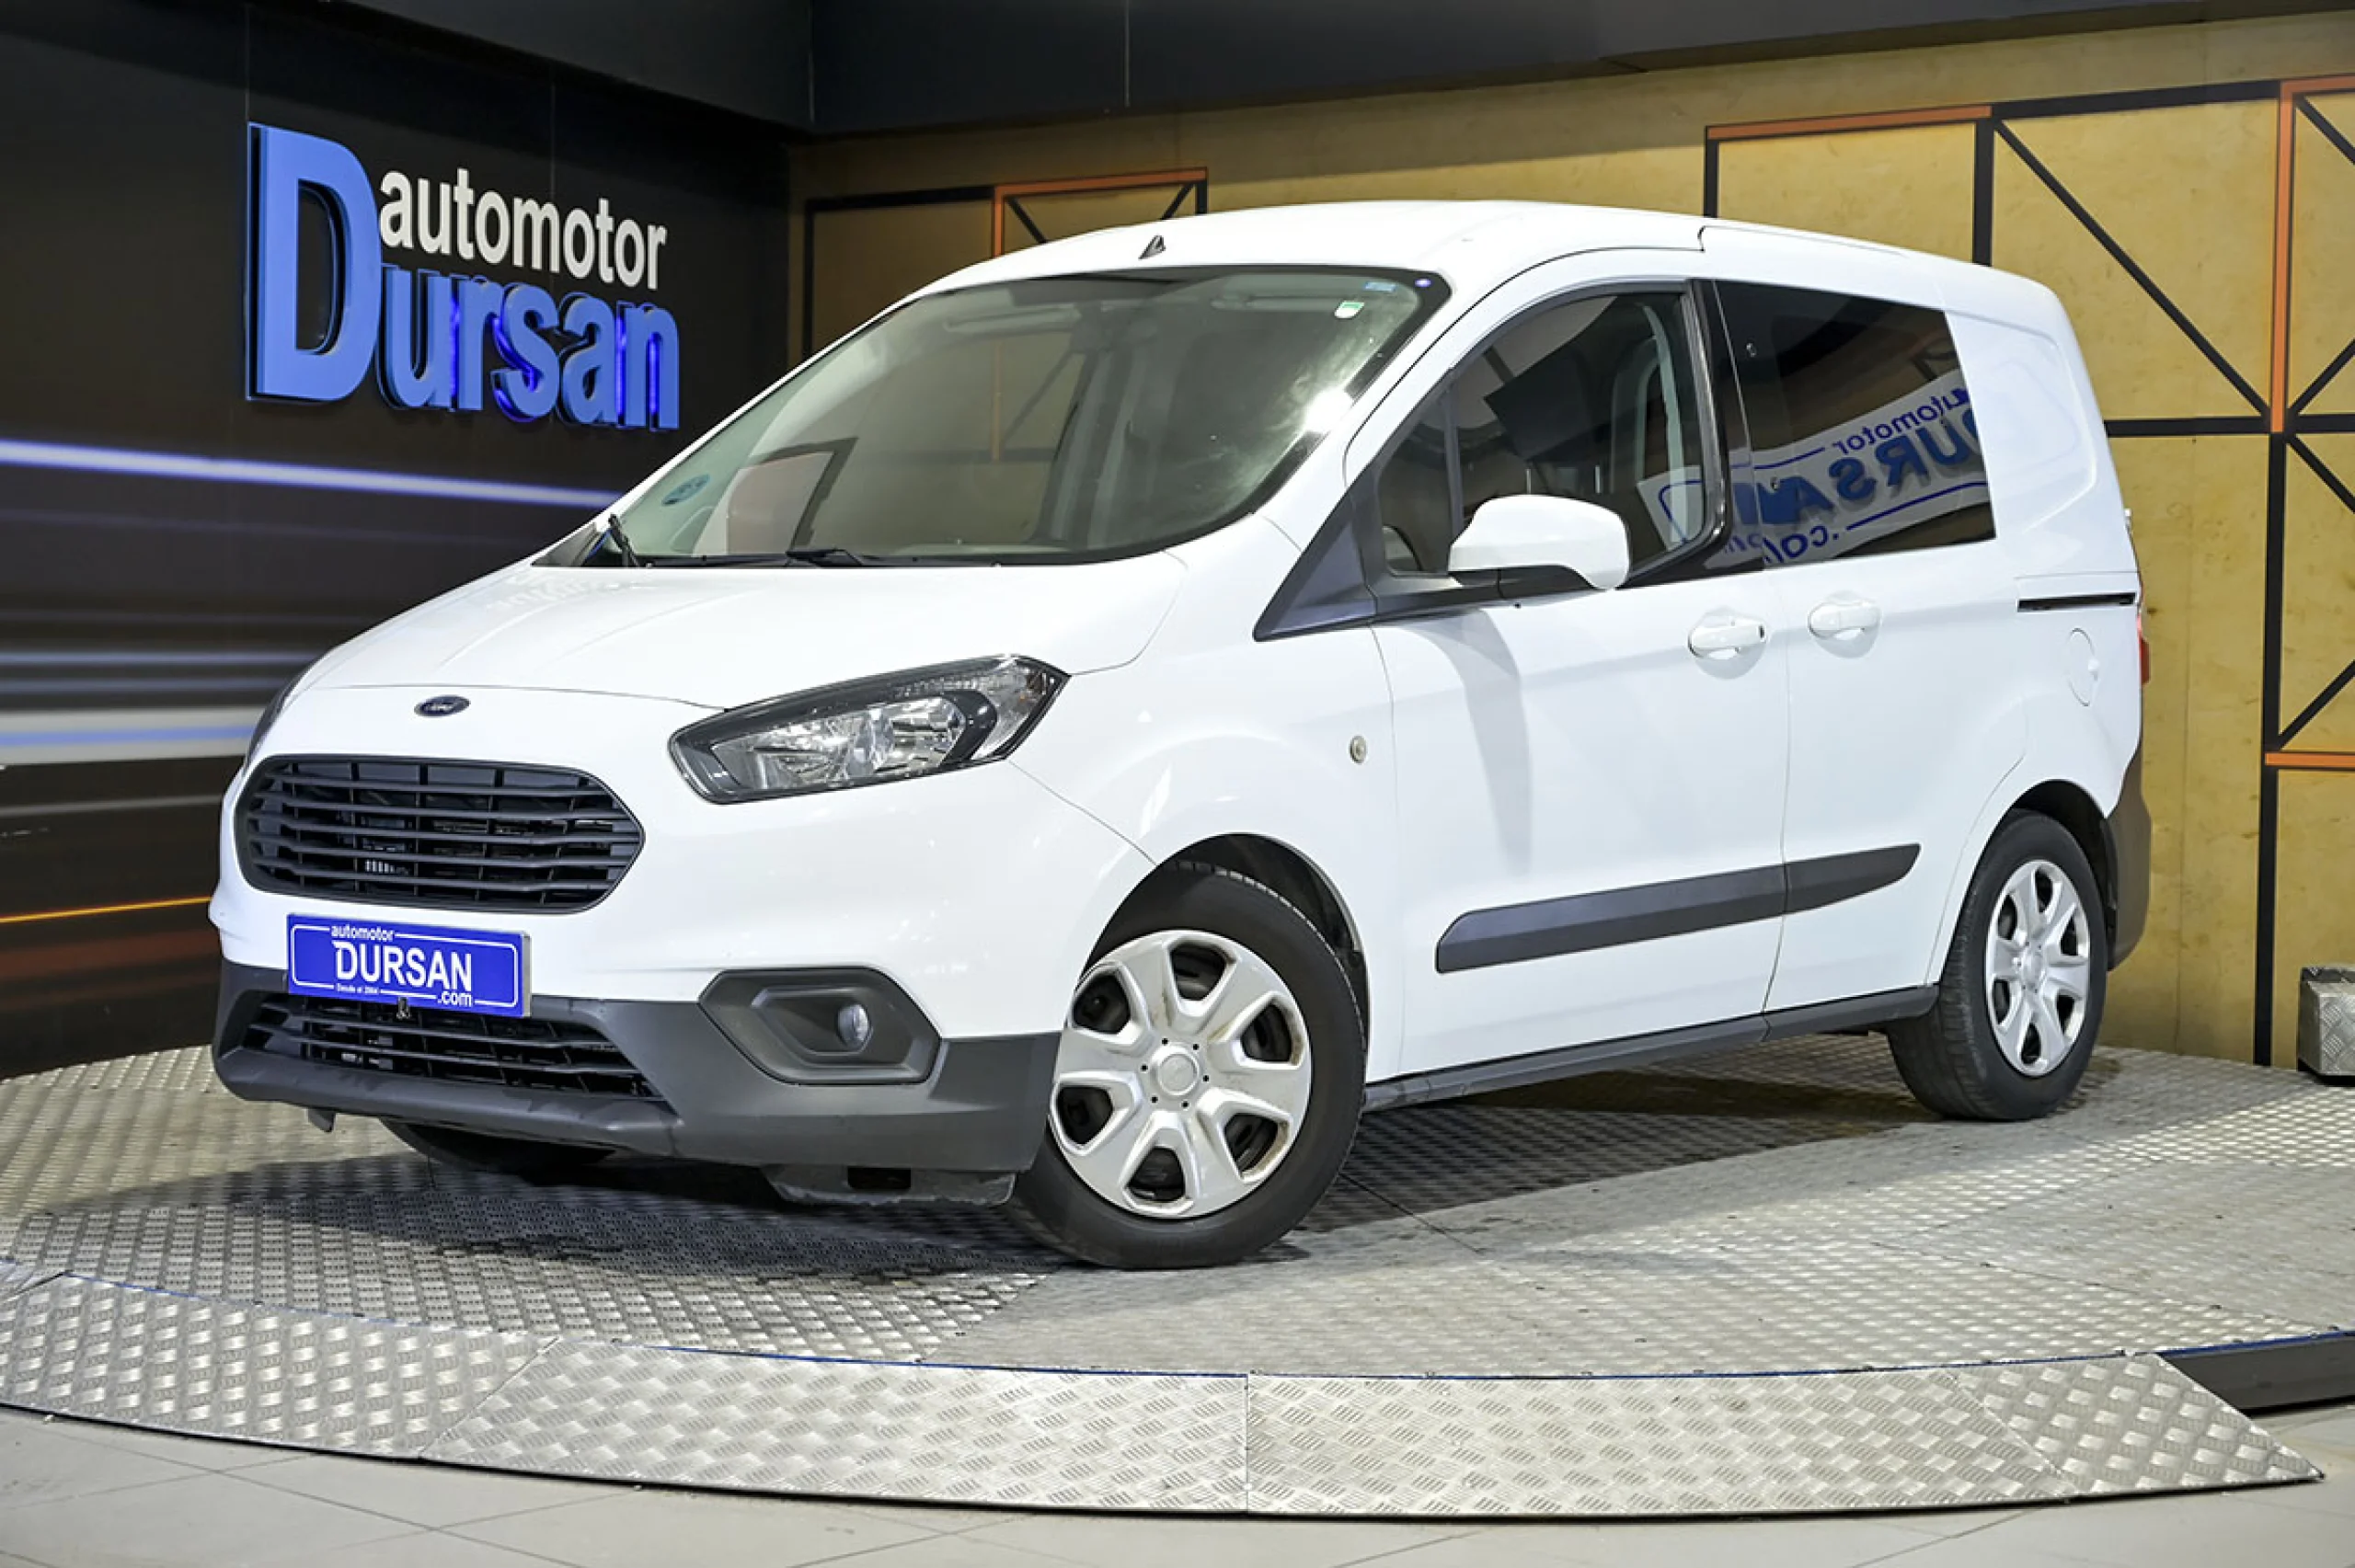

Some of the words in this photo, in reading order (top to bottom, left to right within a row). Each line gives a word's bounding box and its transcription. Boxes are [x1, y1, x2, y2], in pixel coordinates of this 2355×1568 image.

[380, 167, 668, 290] automotor
[247, 120, 680, 430] Dursan
[330, 923, 396, 943] automotor
[331, 939, 473, 992] DURSAN
[437, 990, 473, 1008] .com
